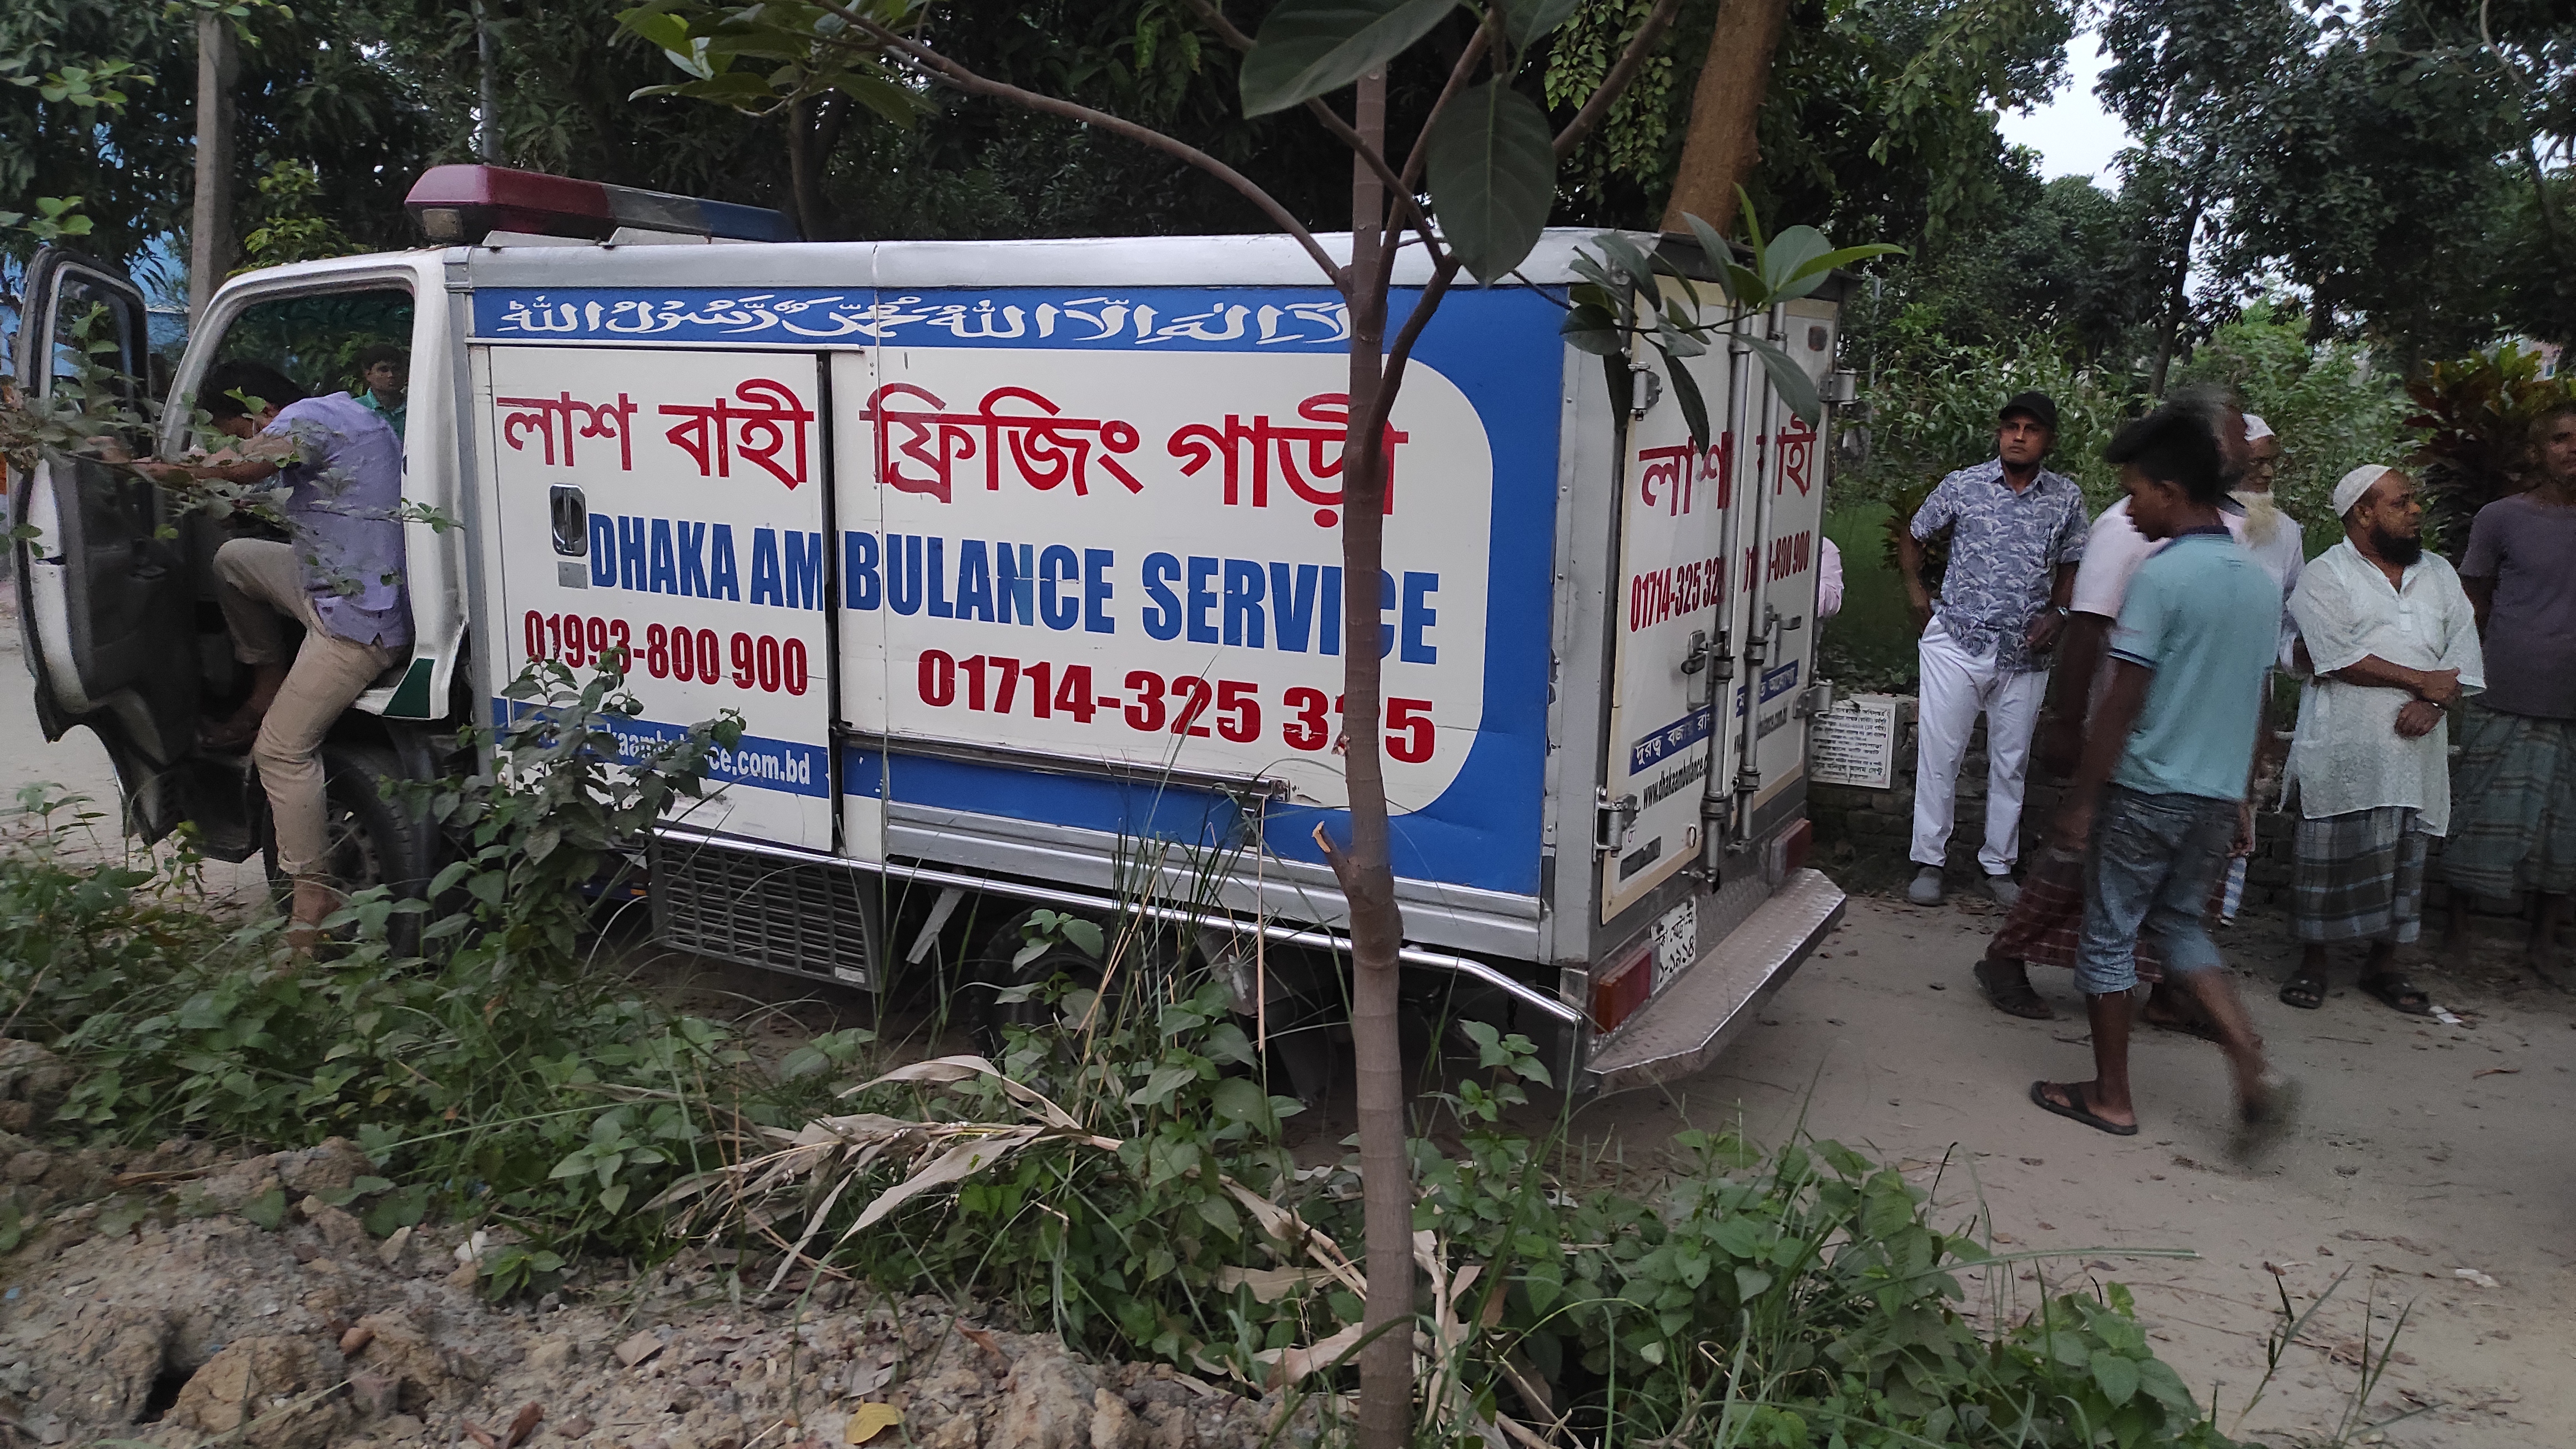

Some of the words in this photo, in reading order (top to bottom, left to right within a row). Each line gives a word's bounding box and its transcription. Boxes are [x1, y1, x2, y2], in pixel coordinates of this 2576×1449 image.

[497, 391, 638, 471] লাশ
[658, 378, 814, 490] বাহী
[859, 383, 1144, 503] ফ্রিজিং
[1639, 431, 1730, 516] লাশ
[588, 513, 741, 602] DHAKA
[750, 527, 1115, 635] AMBULANCE
[1631, 561, 1702, 632] 01714-325
[1703, 556, 1724, 608] 32
[731, 632, 808, 696] 900
[918, 648, 1261, 743] 01714-325
[1283, 687, 1435, 763] 35
